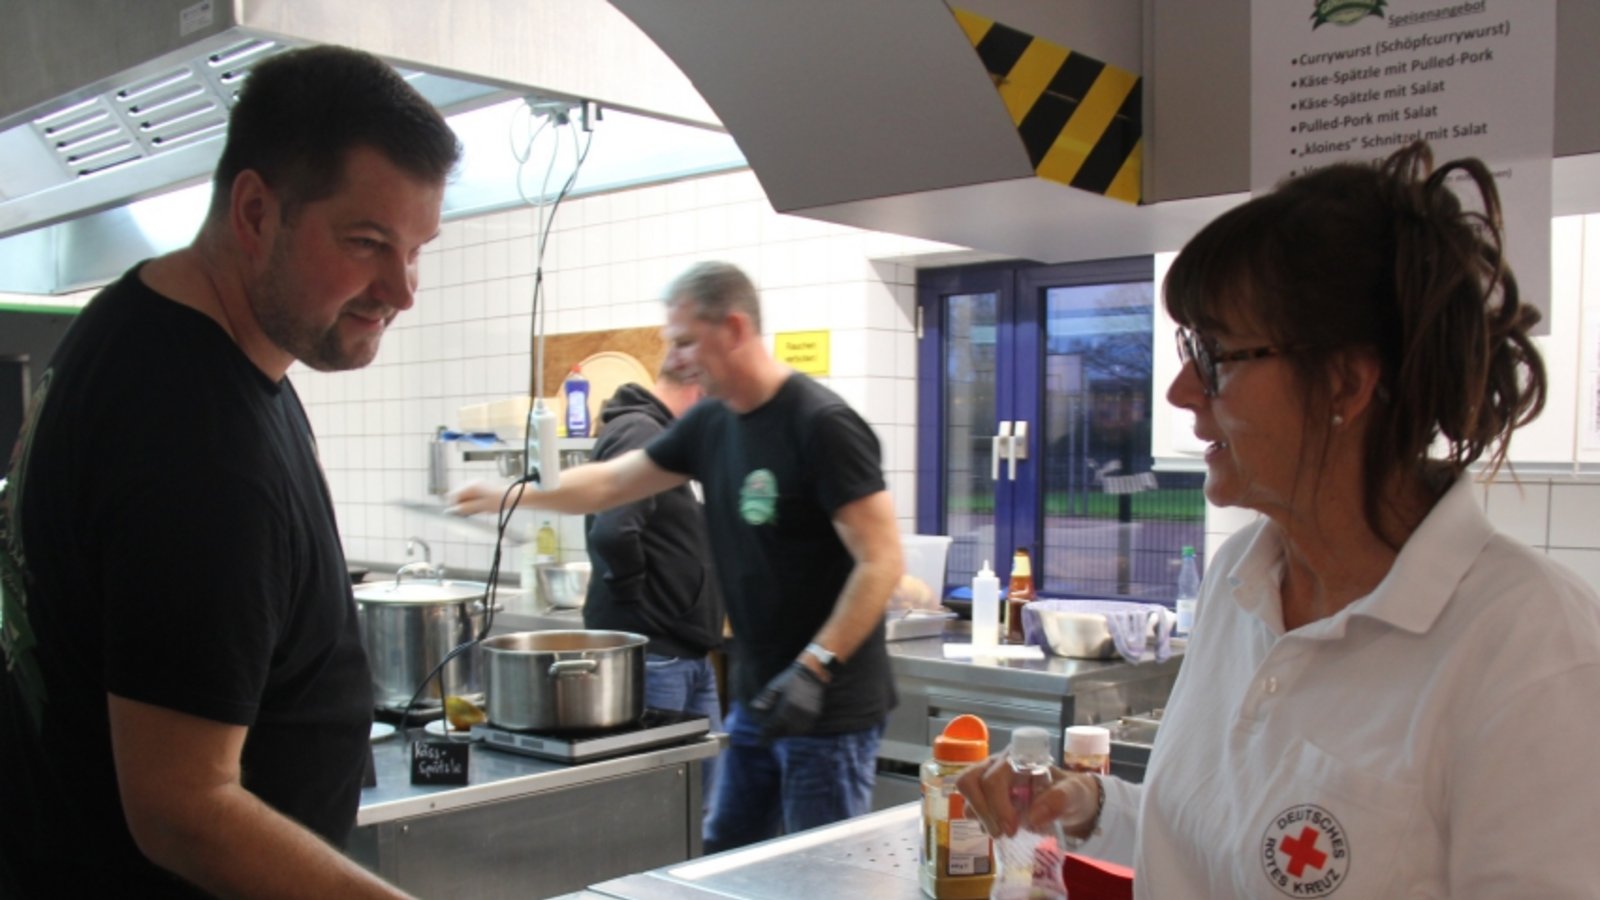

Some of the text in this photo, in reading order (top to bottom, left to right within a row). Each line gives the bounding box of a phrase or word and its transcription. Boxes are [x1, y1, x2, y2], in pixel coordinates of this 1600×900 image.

[1388, 0, 1487, 27] Speisenangebot
[1299, 20, 1511, 66] Currywurst (Schöpfcurrywurst)
[1299, 48, 1494, 88] Käse-Spätzle mit Pulled-Pork
[1299, 80, 1446, 111] Käse-Spätzle mit Salat
[1299, 105, 1438, 133] Pulled-Pork mit Salat
[1361, 128, 1421, 149] Schnitzel
[1424, 126, 1449, 140] mit
[1452, 122, 1488, 138] Salat
[1277, 809, 1346, 859] DEUTSCHES
[1264, 837, 1341, 894] ROTES KREUZ
